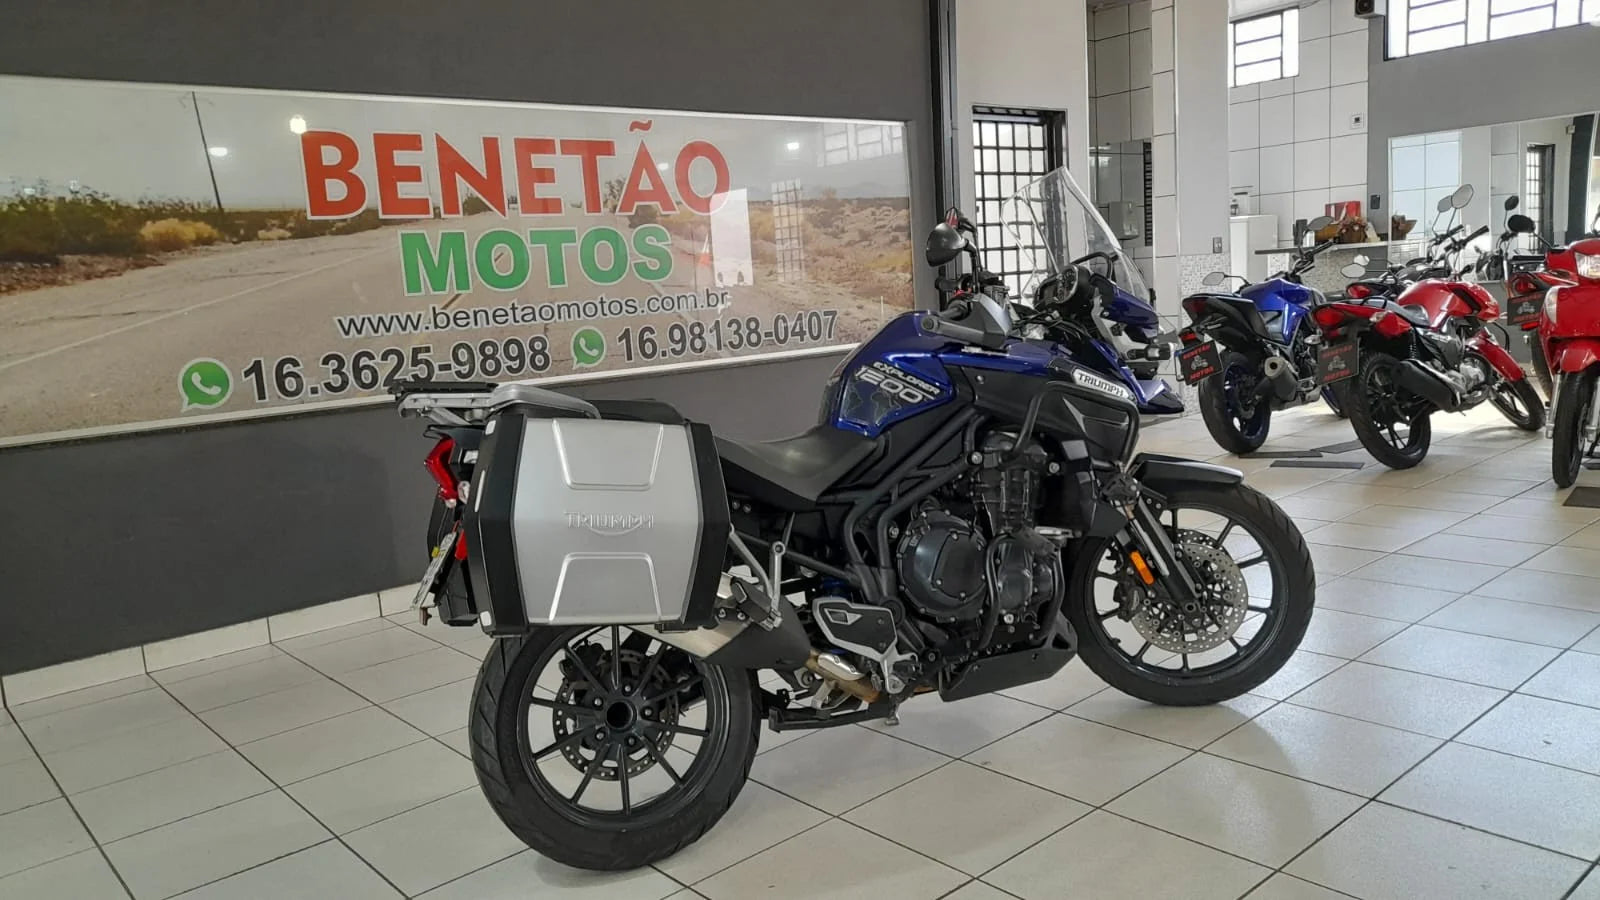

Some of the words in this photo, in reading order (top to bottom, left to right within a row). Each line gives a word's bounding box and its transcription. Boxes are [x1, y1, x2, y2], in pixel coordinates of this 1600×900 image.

[300, 119, 731, 219] BENETÃO
[400, 224, 674, 296] MOTOS
[337, 288, 729, 337] www.benetaomotos.com.br
[617, 310, 838, 361] 16.98138-0407
[242, 335, 551, 401] 16.3625-9898
[854, 365, 924, 404] 1200
[873, 361, 941, 395] EXPLORER
[1078, 372, 1125, 397] TRIUMPH
[563, 511, 655, 529] TRIUMPH
